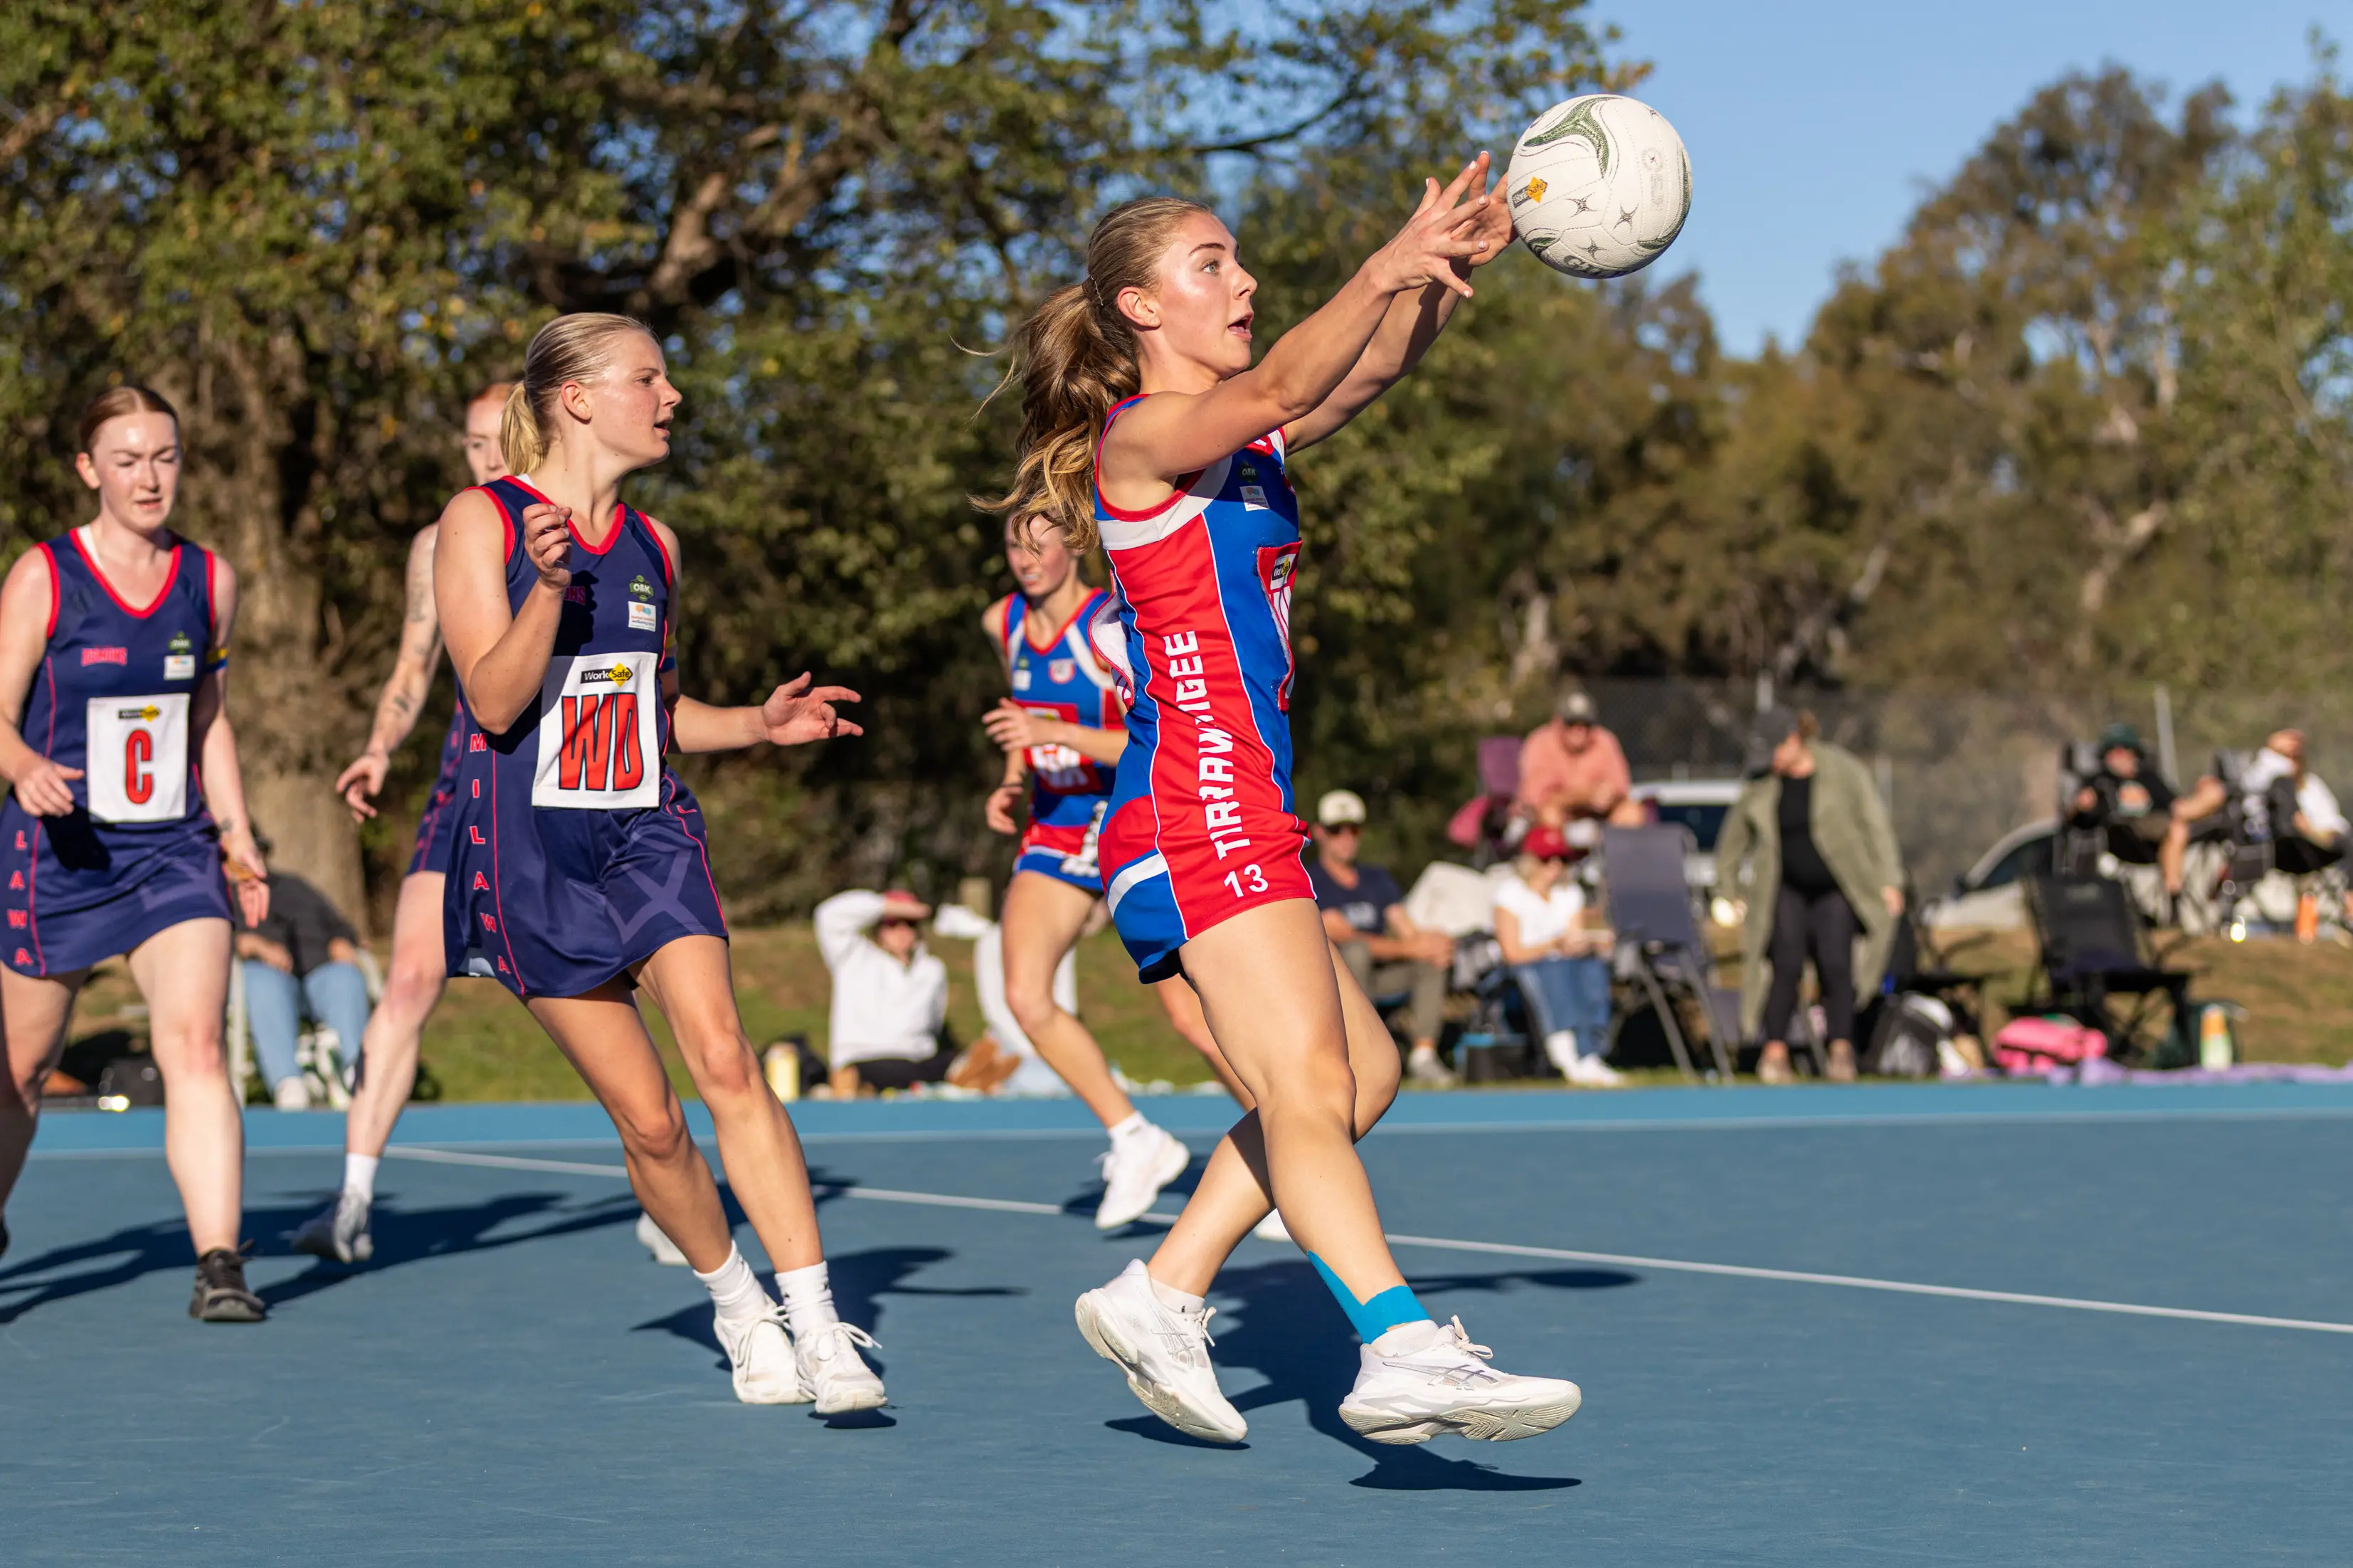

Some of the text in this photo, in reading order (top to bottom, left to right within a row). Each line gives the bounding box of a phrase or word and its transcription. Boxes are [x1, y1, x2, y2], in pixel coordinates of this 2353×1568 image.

[633, 583, 650, 593] O&K
[125, 728, 154, 805] C
[559, 692, 644, 791] WD
[6, 830, 34, 966] LAWA
[1223, 863, 1269, 898] 13
